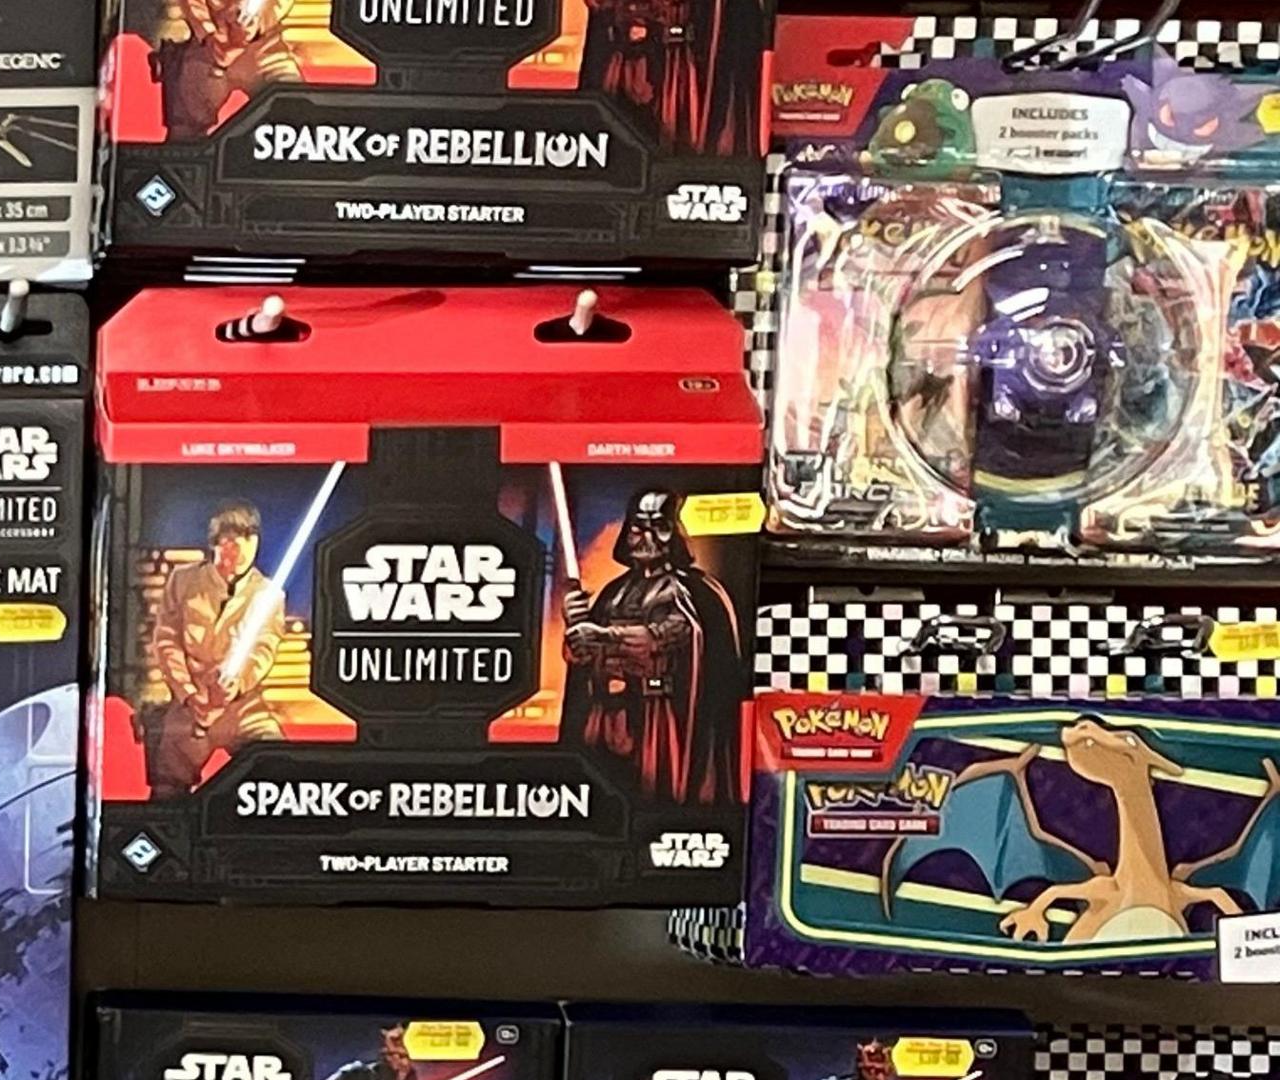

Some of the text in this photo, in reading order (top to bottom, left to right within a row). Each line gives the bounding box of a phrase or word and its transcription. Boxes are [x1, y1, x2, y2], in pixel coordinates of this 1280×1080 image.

[359, 0, 534, 27] UNLIMITED
[1012, 107, 1089, 120] INCLUDES
[999, 126, 1007, 138] 2
[1061, 127, 1099, 141] packs
[253, 124, 608, 168] SPARK OF REBELLION
[668, 184, 747, 204] STAR
[5, 201, 24, 218] 35
[26, 204, 48, 218] cm
[336, 202, 524, 223] TWO-PLAYER STARTER
[668, 202, 746, 221] WARS
[587, 443, 631, 456] DARTH
[342, 544, 516, 582] STAR
[7, 567, 61, 594] MAT
[342, 583, 516, 623] WARS
[338, 647, 513, 683] UNLIMITED
[237, 781, 590, 818] SPARK OF REBELLION
[650, 833, 729, 852] STAR
[320, 855, 508, 872] TWO-PLAYER STARTER
[649, 848, 729, 869] WARS
[1234, 946, 1241, 959] 2
